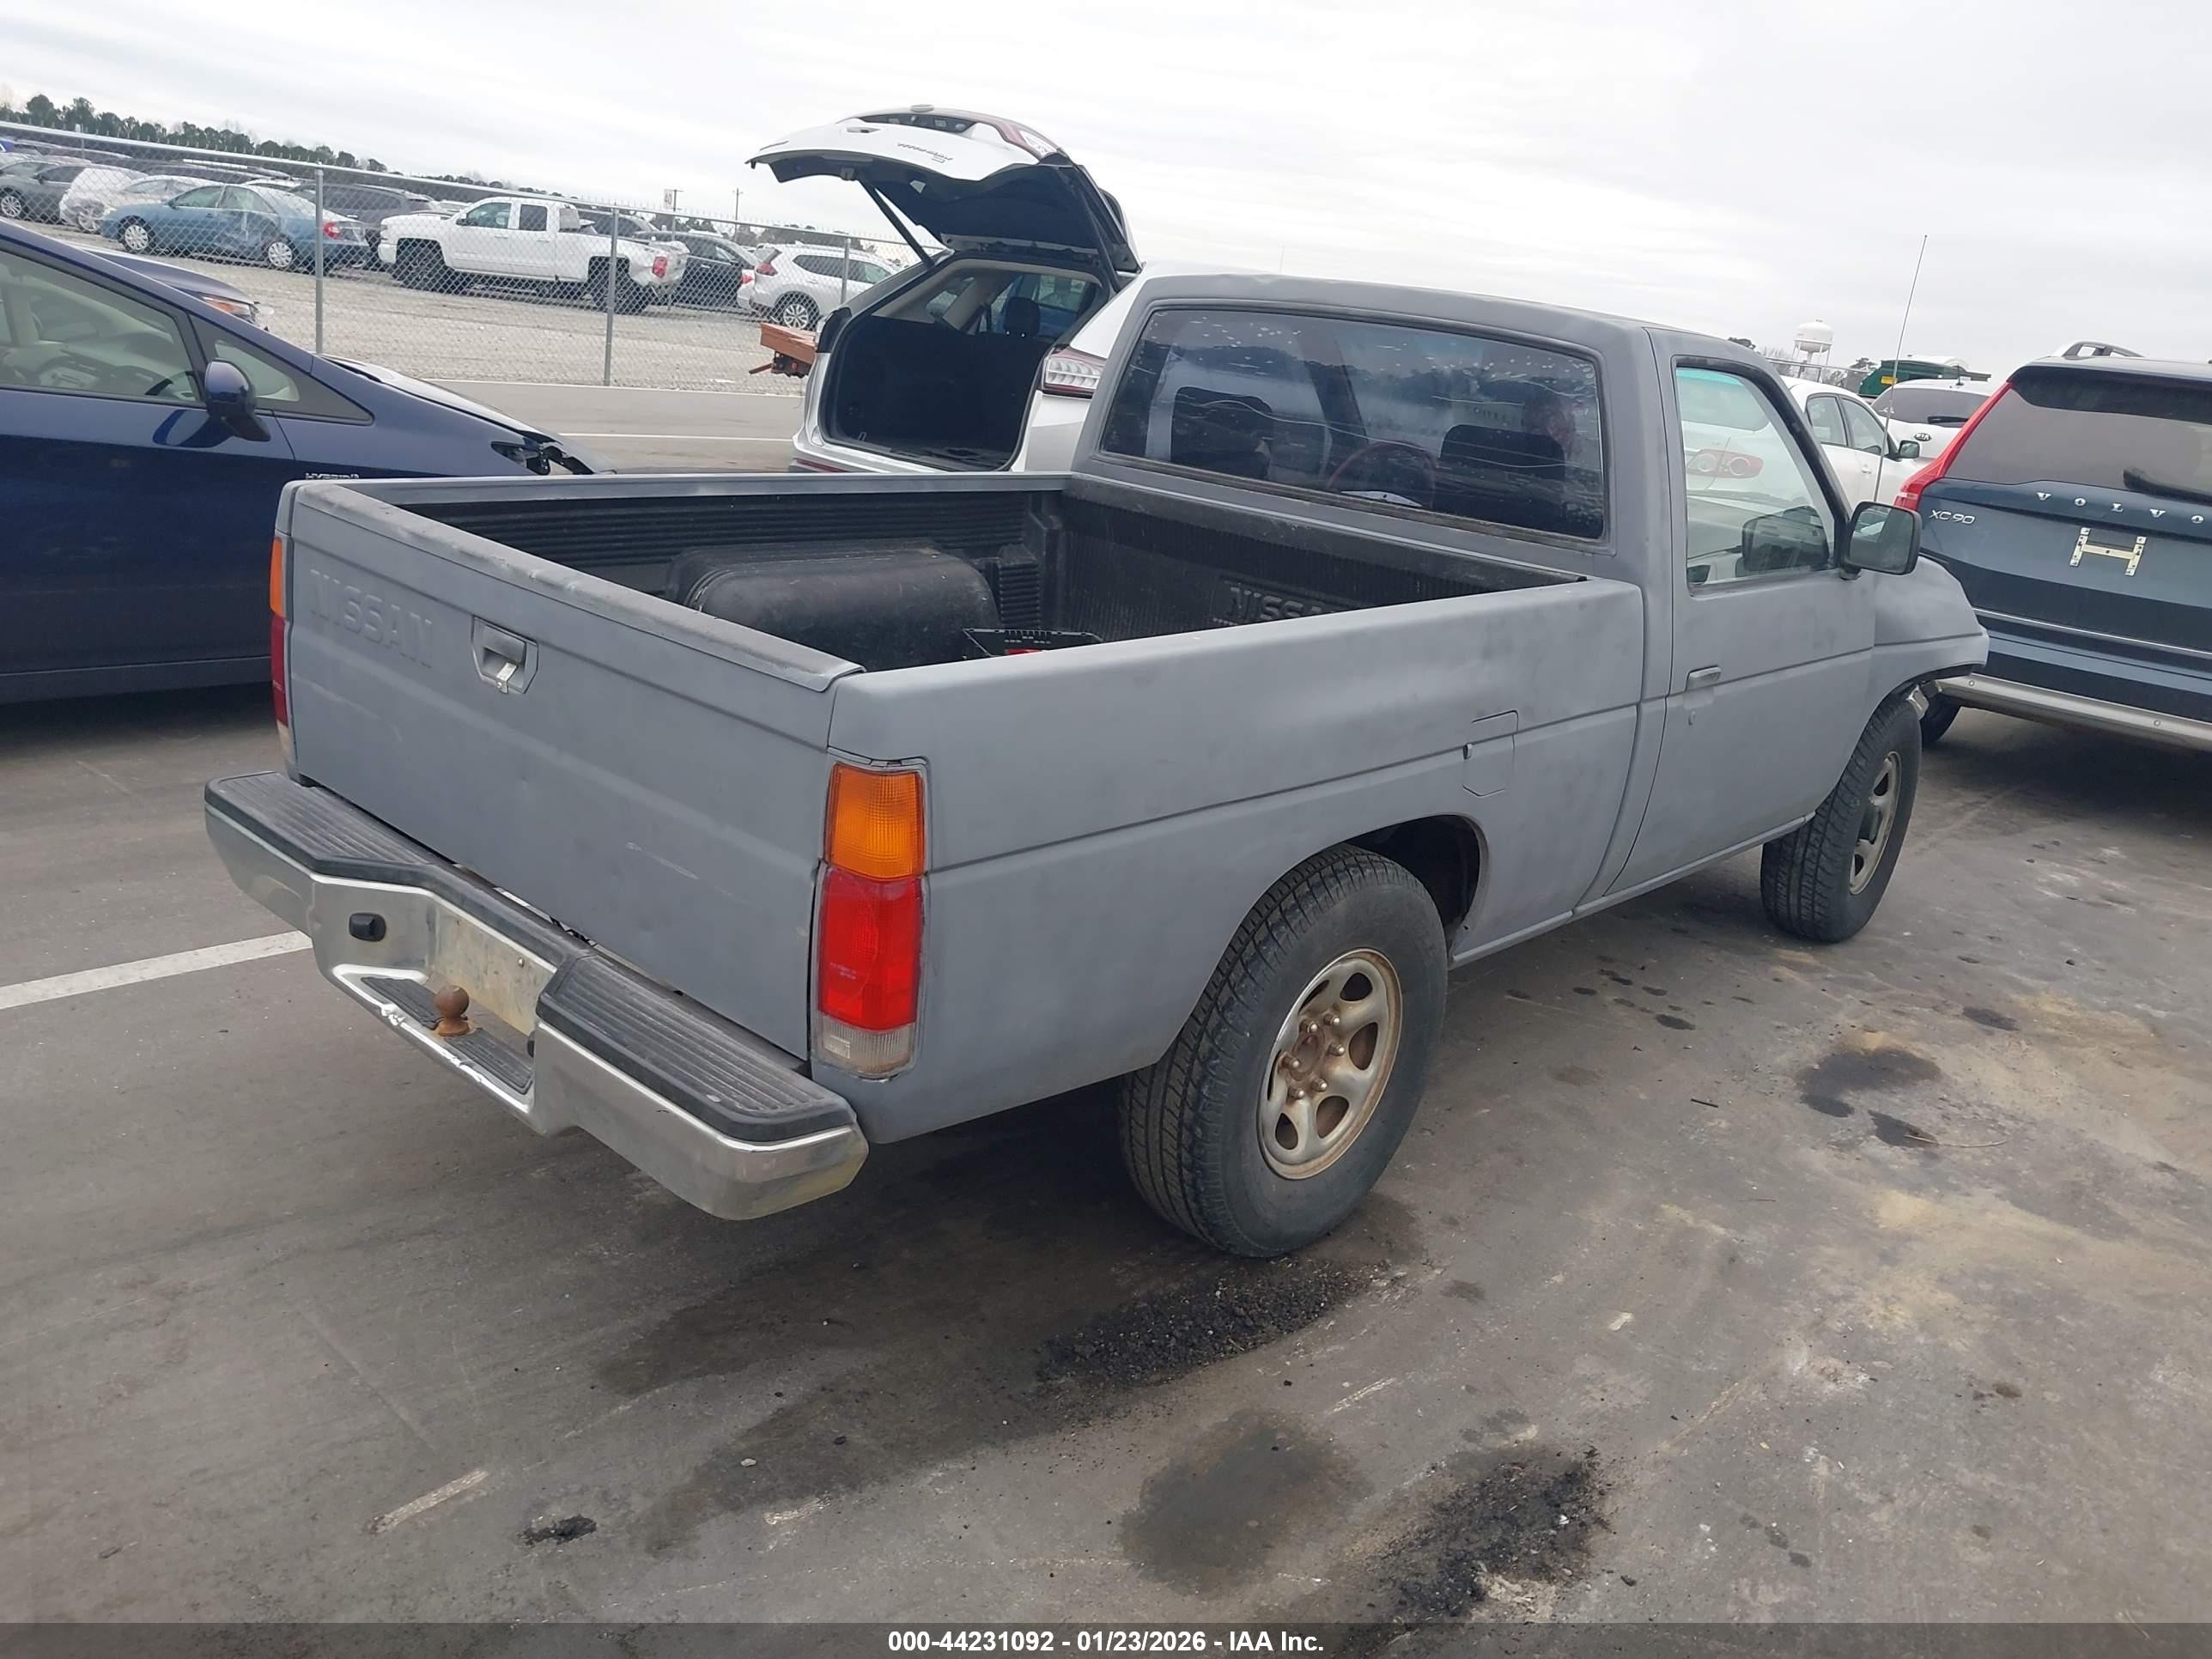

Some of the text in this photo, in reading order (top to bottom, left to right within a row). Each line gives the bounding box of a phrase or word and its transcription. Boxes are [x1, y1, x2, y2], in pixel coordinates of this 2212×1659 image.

[1915, 432, 1931, 441] KIA
[2036, 491, 2205, 525] VOLVO
[309, 568, 434, 669] NISSAN
